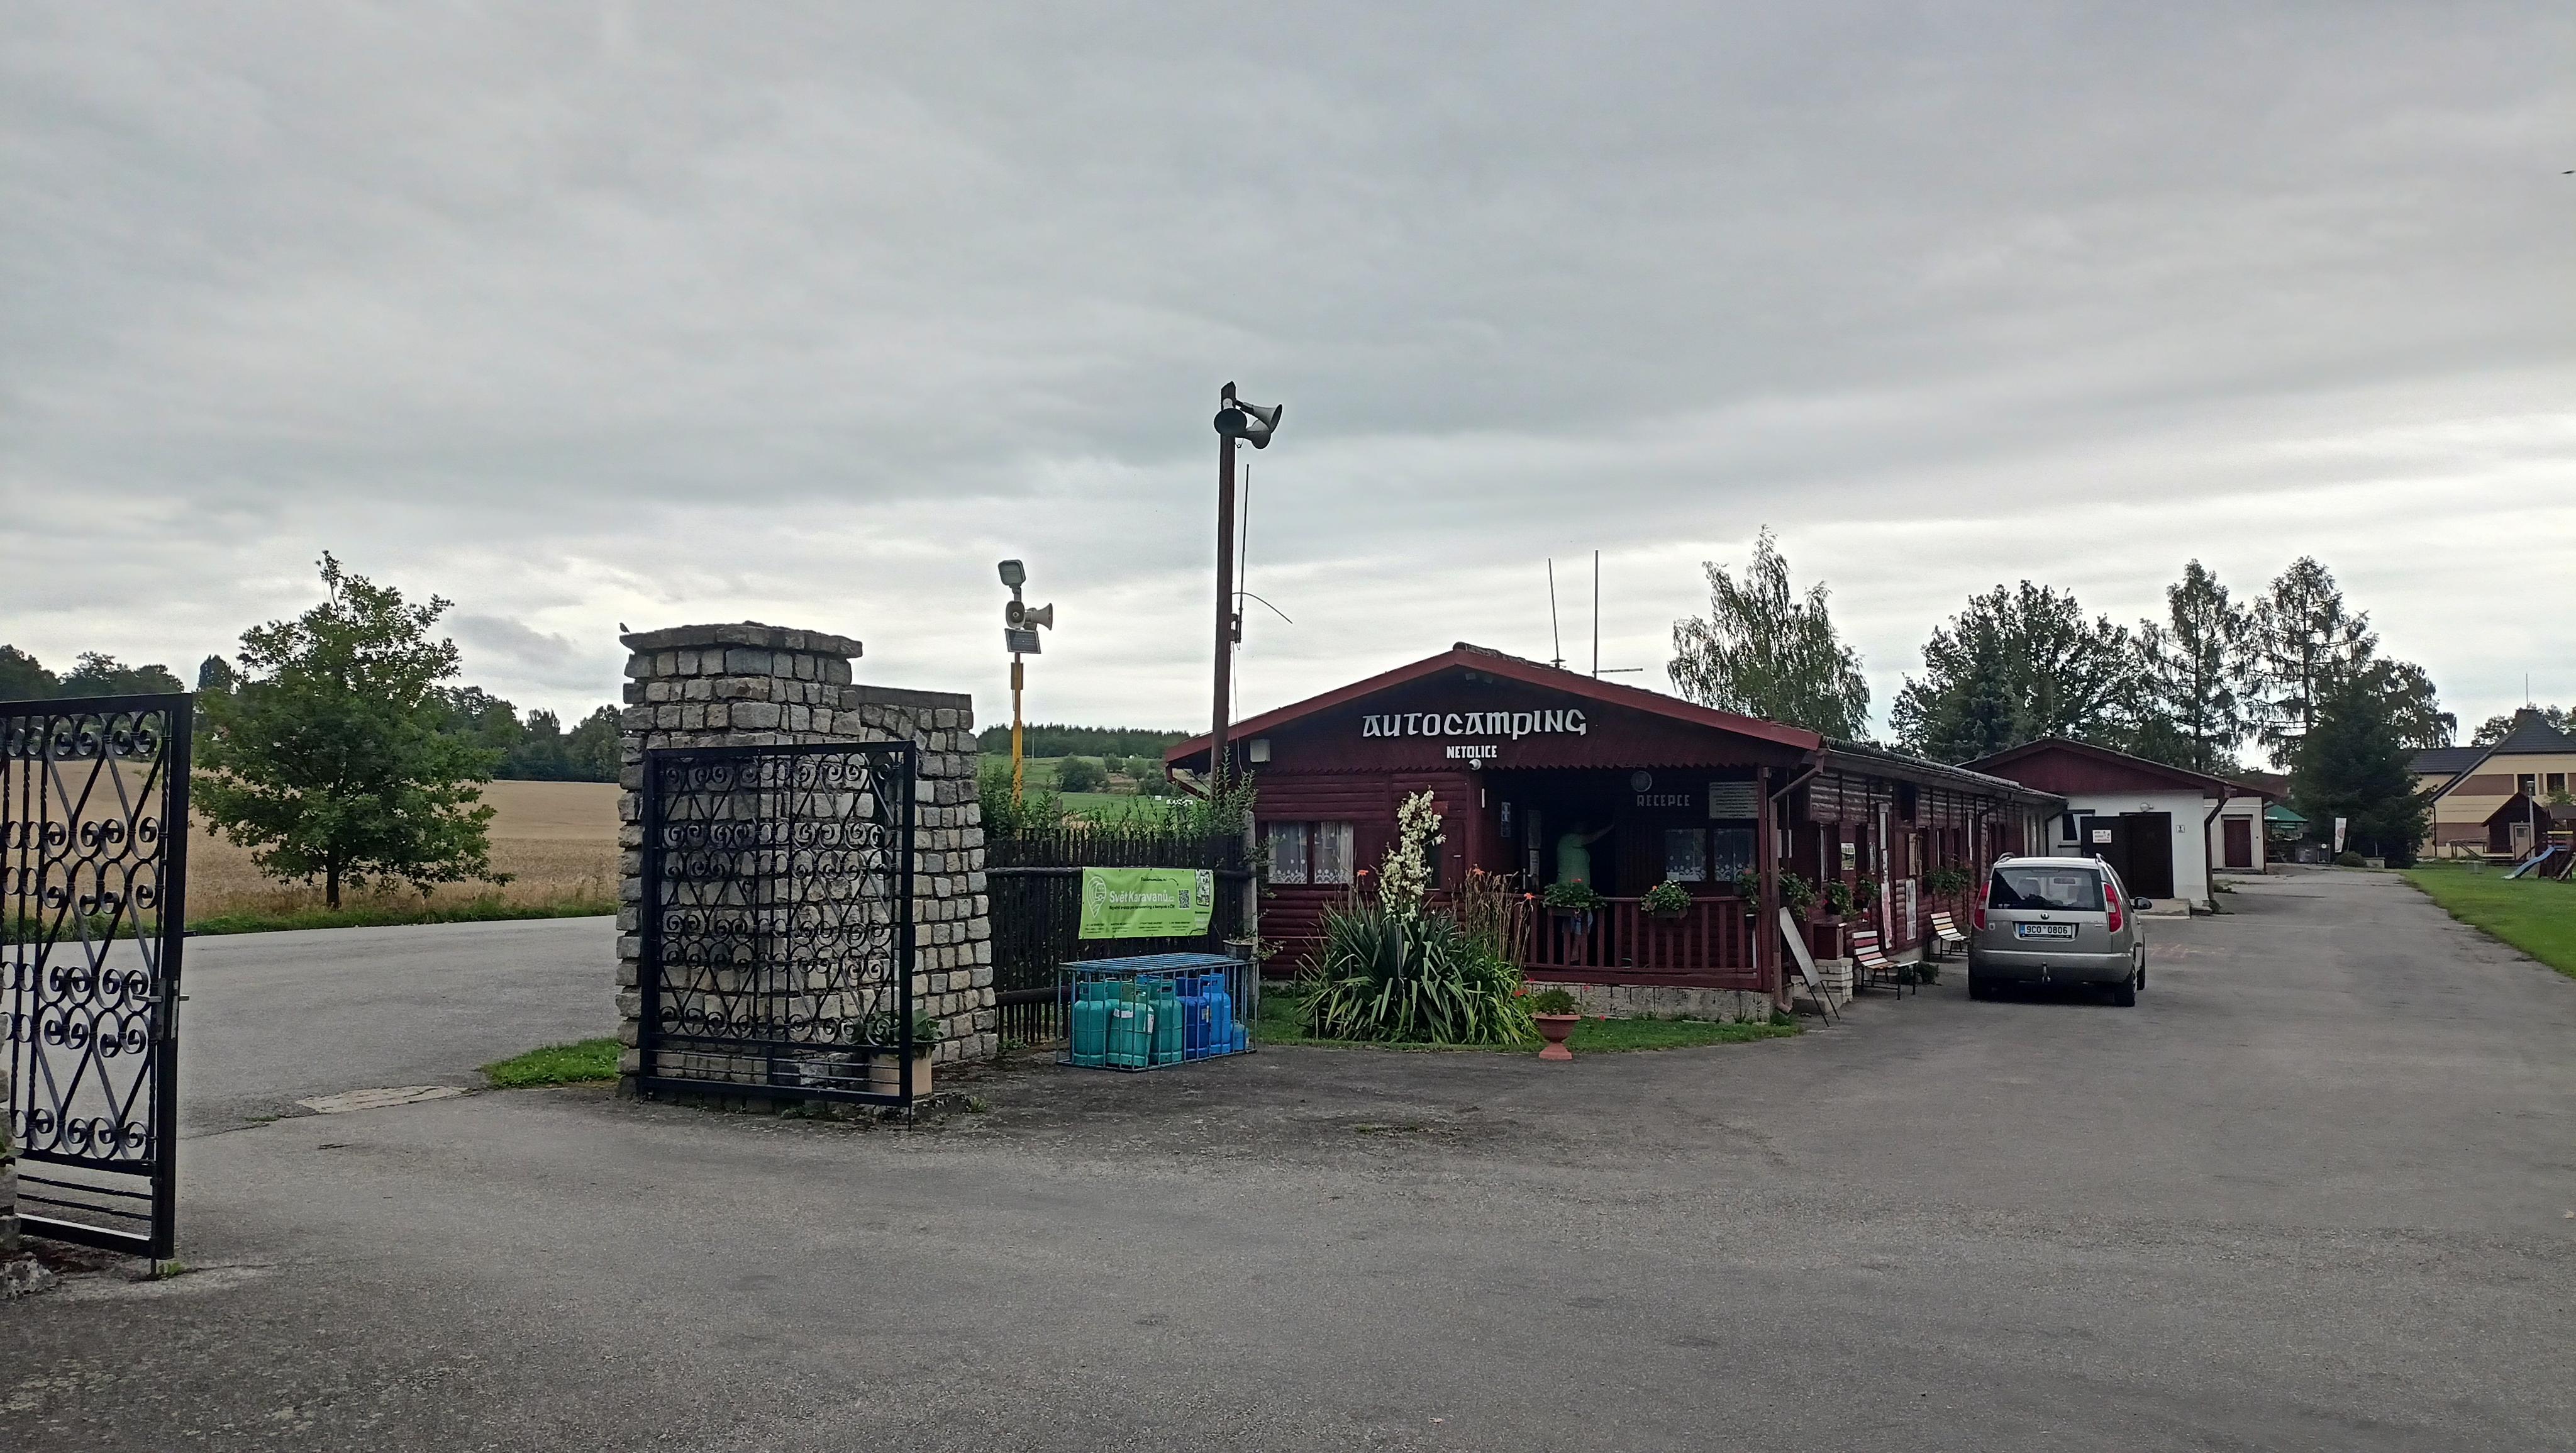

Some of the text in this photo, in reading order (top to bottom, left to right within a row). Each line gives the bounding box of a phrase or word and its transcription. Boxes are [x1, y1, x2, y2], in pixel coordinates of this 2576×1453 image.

[1362, 709, 1587, 740] AUTOCAMPING
[1446, 745, 1497, 759] NETOLICE
[1636, 794, 1690, 806] RECEPCE
[2047, 926, 2068, 934] 0806
